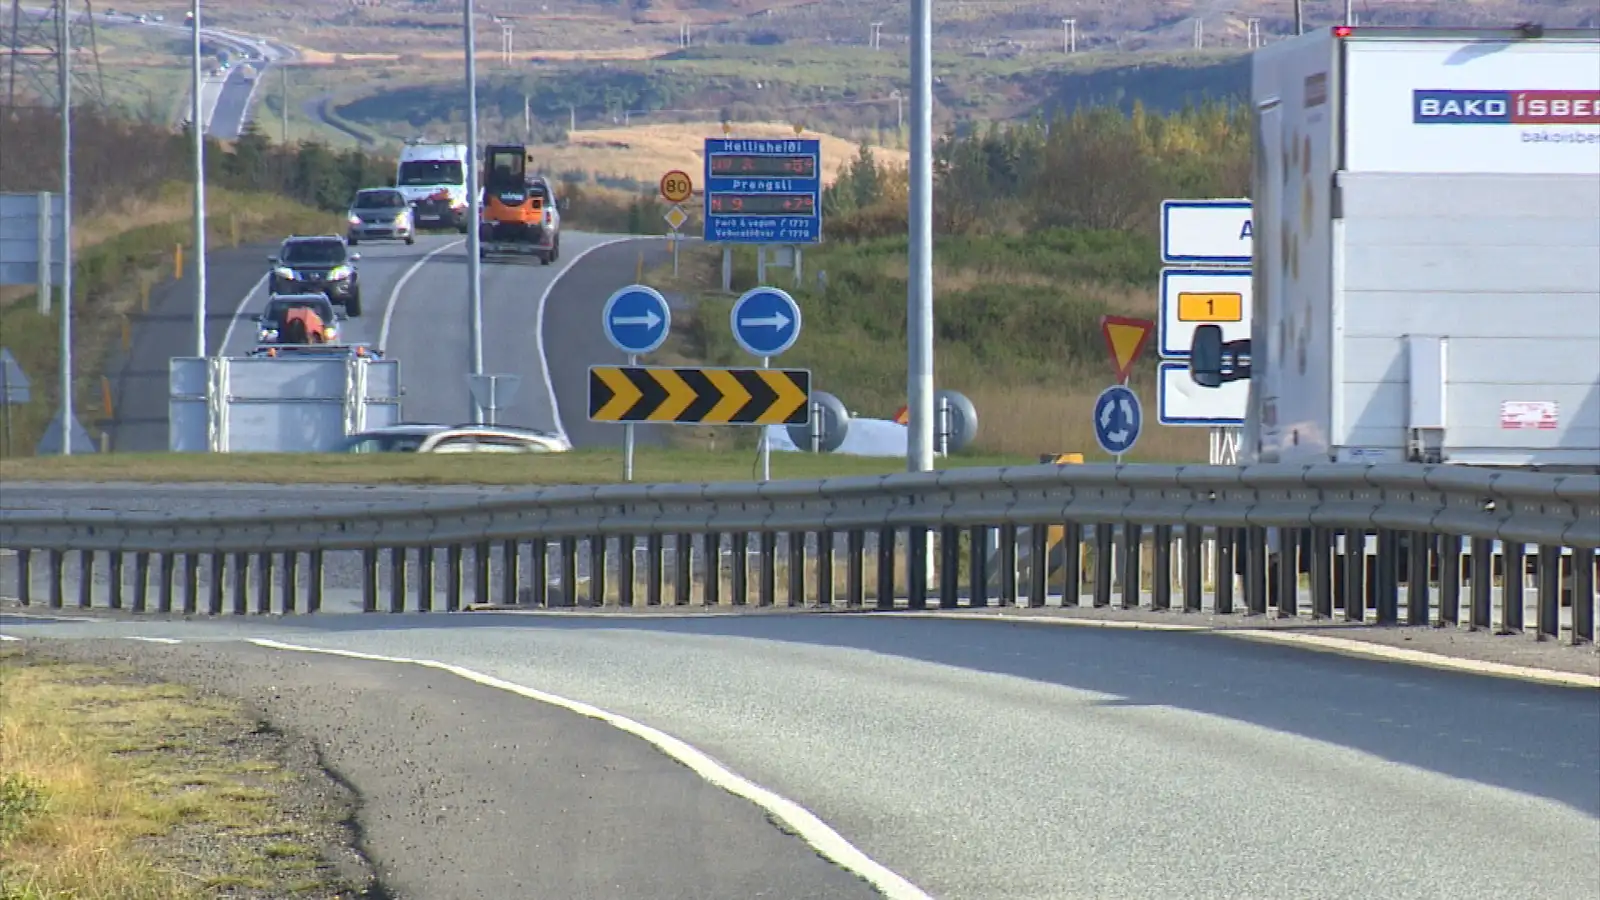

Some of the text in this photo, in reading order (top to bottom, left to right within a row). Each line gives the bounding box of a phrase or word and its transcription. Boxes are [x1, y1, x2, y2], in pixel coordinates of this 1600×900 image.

[1419, 99, 1506, 116] BAKO
[724, 141, 801, 153] Hellisheiði
[666, 179, 687, 193] 80
[1206, 299, 1214, 316] 1
